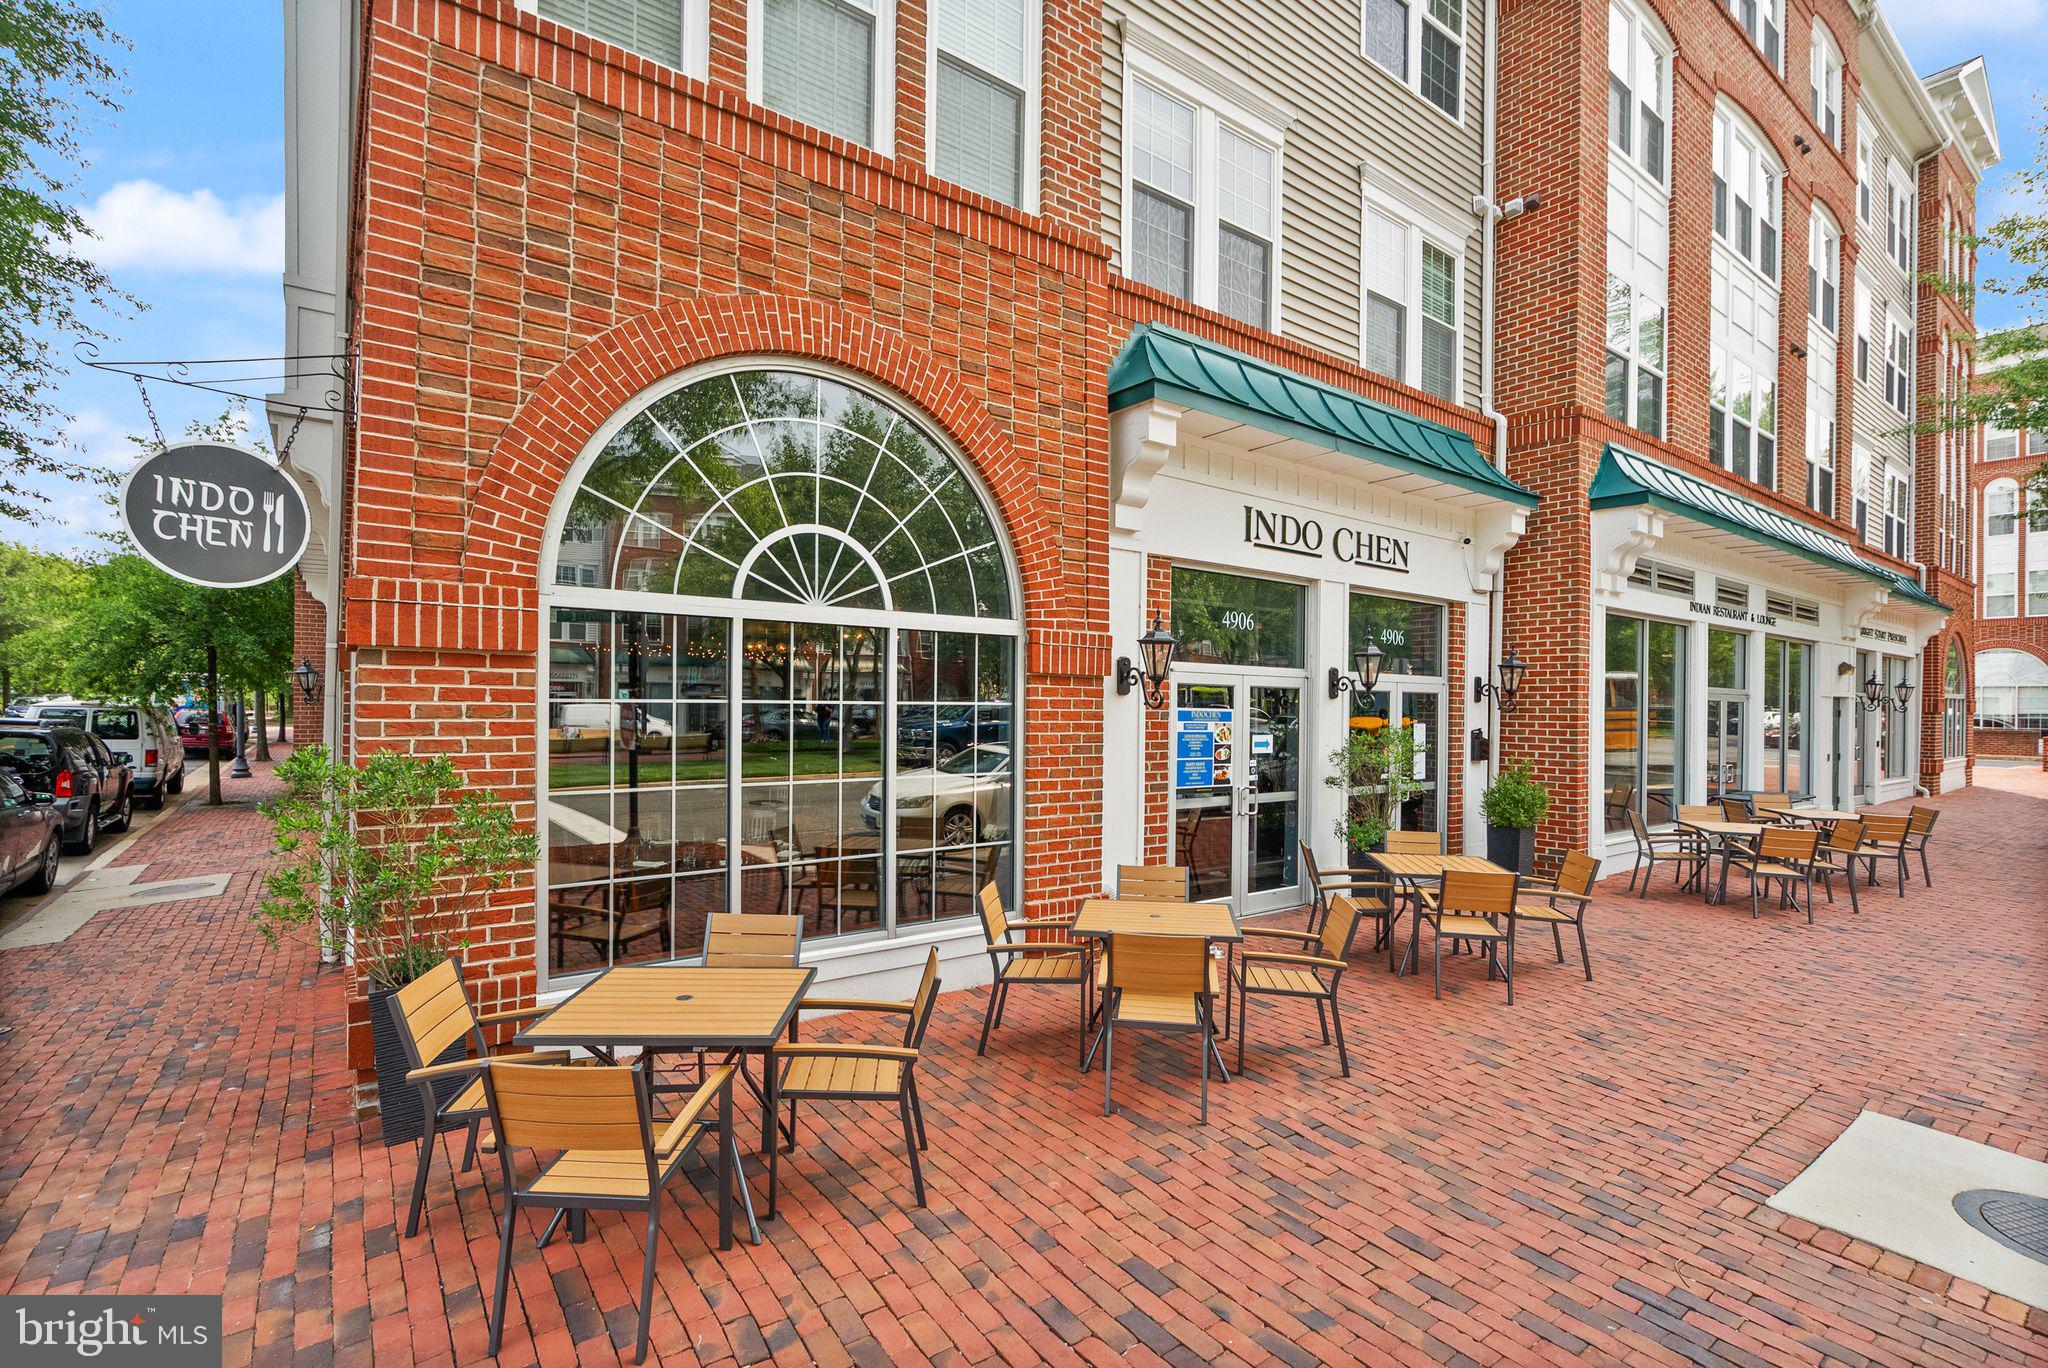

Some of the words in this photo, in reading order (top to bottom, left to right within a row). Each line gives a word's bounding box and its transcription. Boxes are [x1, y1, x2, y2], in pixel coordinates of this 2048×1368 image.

[152, 474, 255, 516] INDO
[151, 508, 255, 551] CHEN
[1243, 505, 1323, 550] INDO
[1332, 527, 1410, 568] CHEN
[1222, 610, 1254, 631] 4906
[1689, 601, 1711, 615] INDIAN
[1713, 605, 1749, 621] RESTAURANT
[1750, 613, 1755, 623] &
[1757, 614, 1777, 627] LOUNGE
[1380, 628, 1405, 646] 4906
